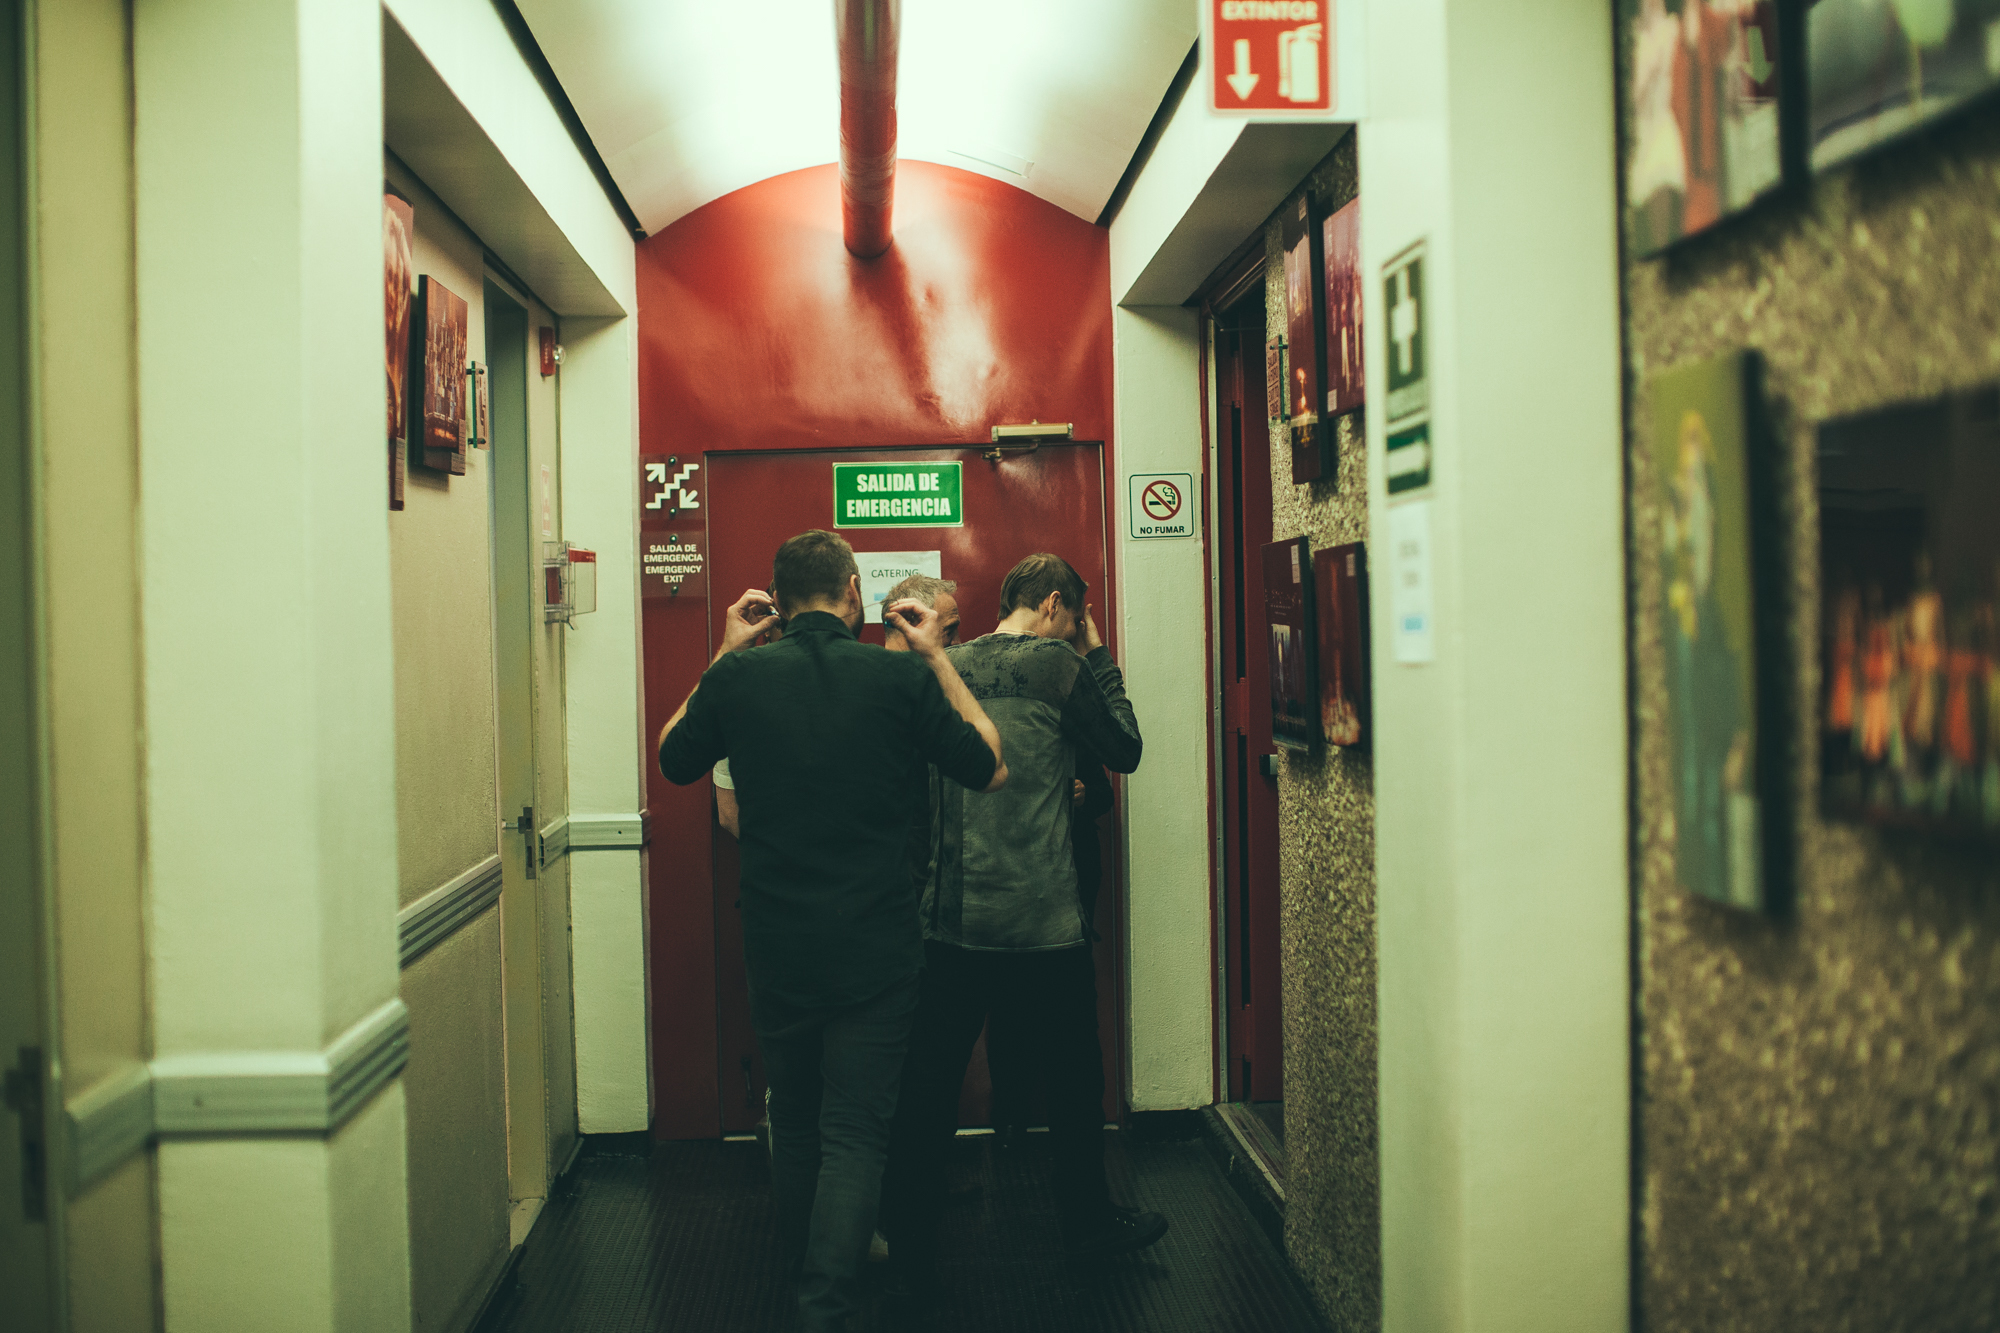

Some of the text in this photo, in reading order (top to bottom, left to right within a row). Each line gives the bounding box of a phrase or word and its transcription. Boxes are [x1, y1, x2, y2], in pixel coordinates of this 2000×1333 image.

[1222, 1, 1317, 20] EXTINTOR
[857, 473, 939, 492] SALIDA DE
[847, 498, 951, 517] EMERGENCIA
[1140, 526, 1185, 535] NO FUMAR
[650, 544, 697, 553] SALIDA DE
[644, 553, 703, 563] EMERGENCIA
[645, 565, 702, 574] EMERGENCY
[871, 568, 919, 578] CATERING
[664, 575, 684, 583] EXIT
